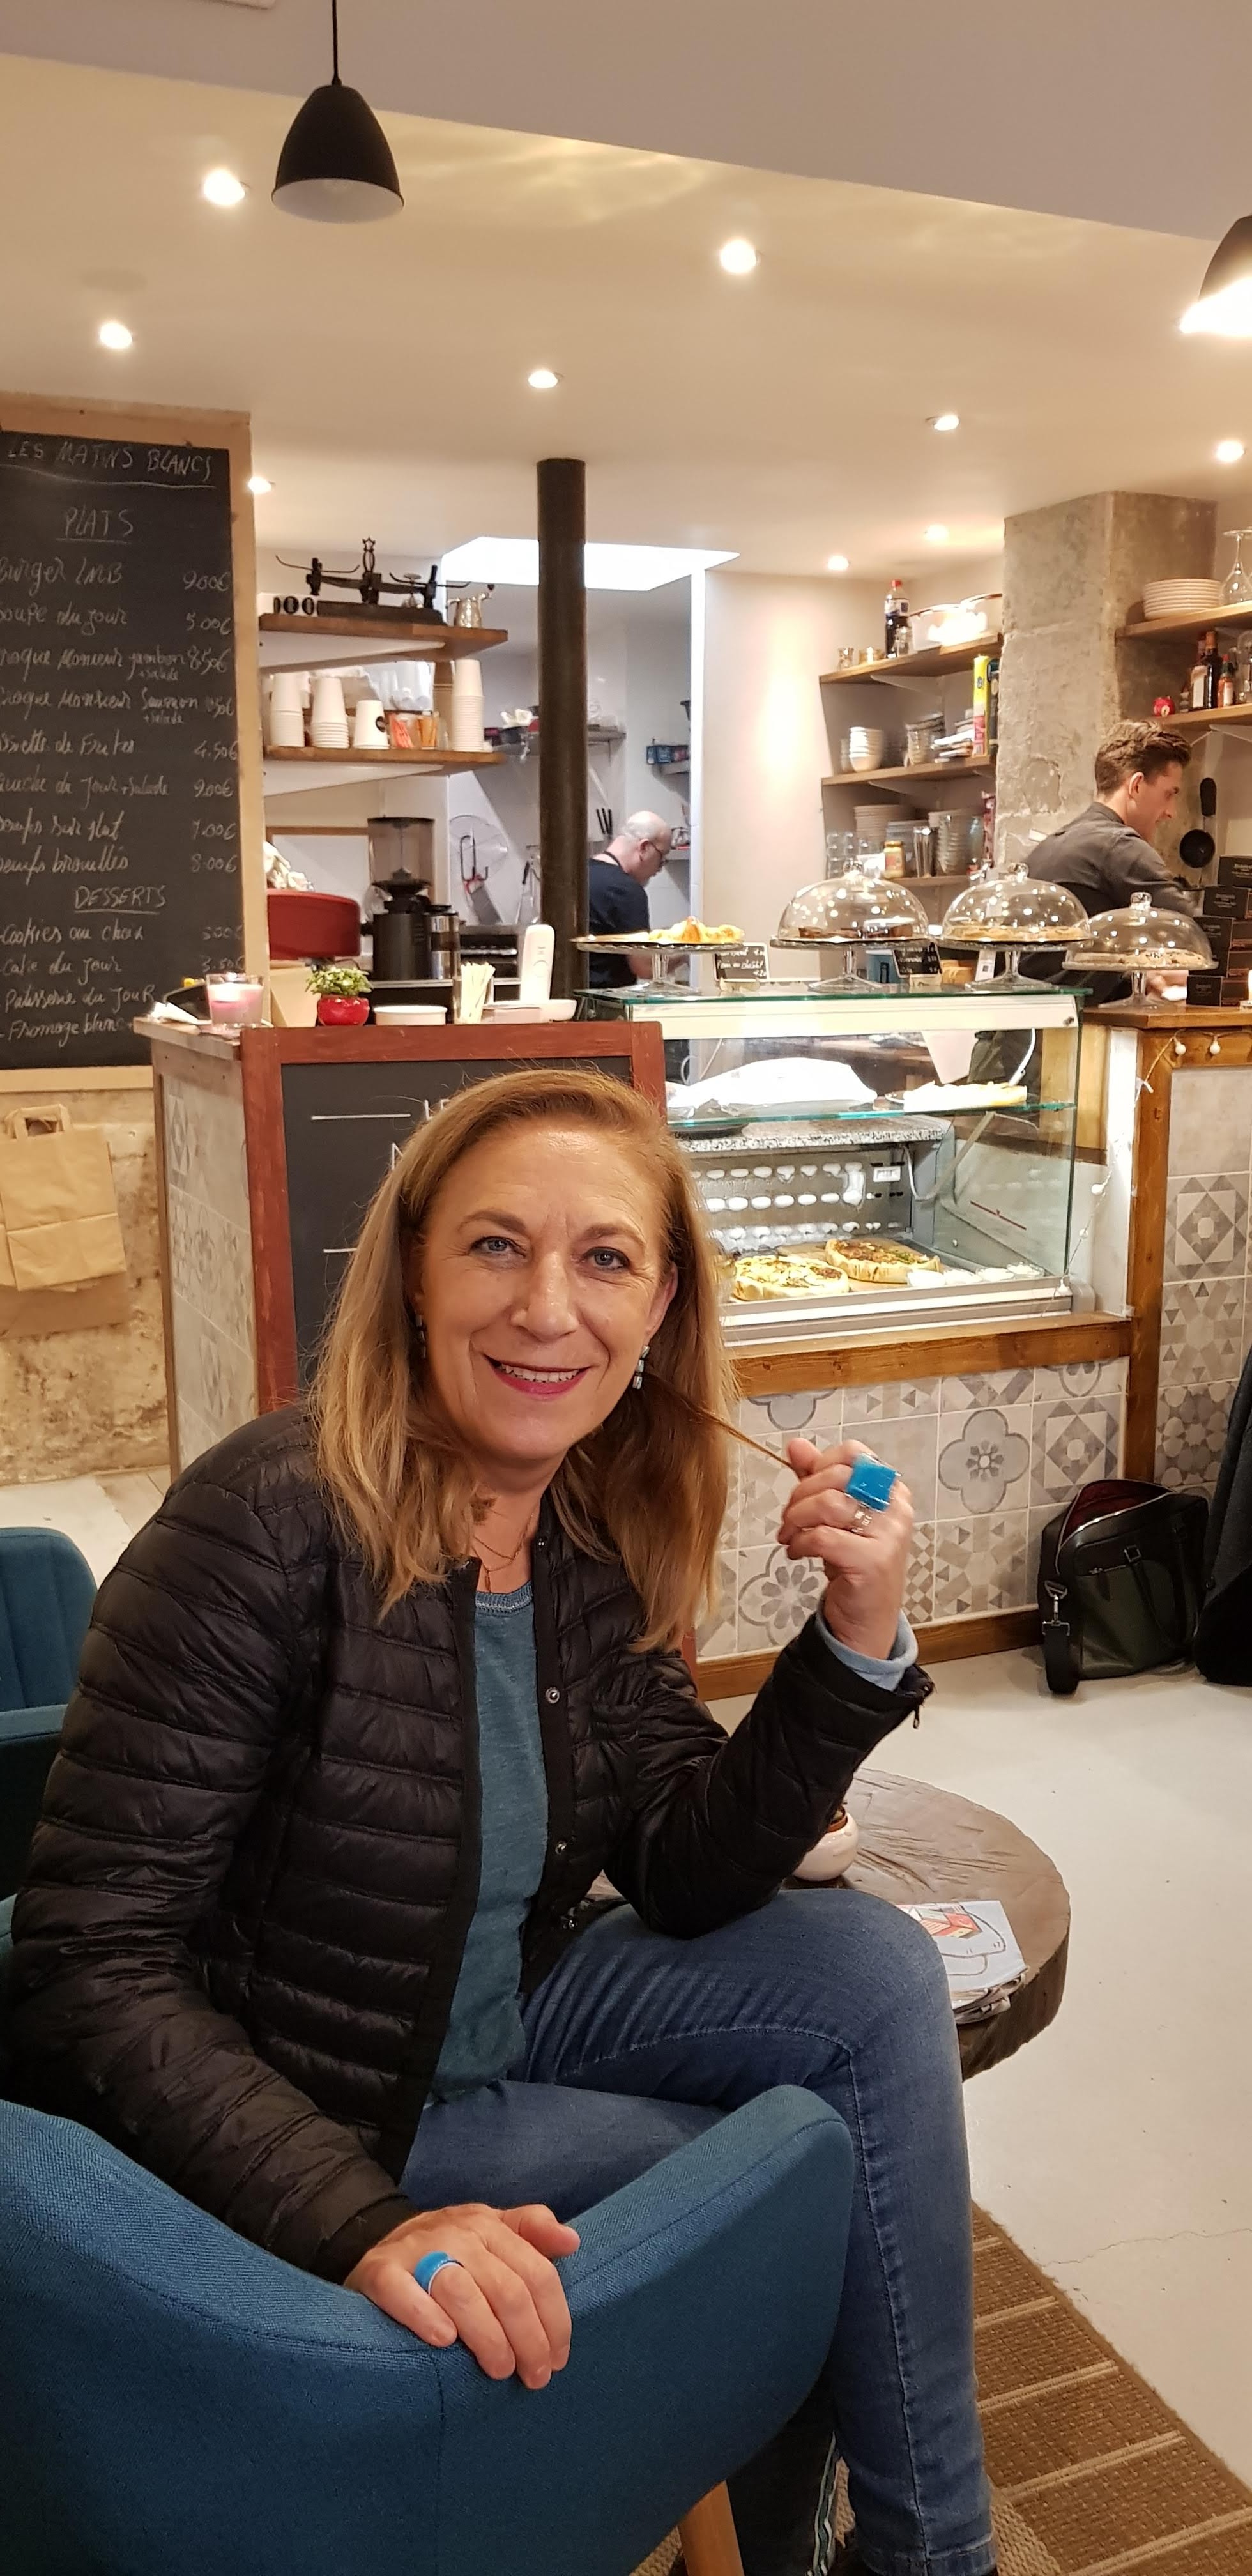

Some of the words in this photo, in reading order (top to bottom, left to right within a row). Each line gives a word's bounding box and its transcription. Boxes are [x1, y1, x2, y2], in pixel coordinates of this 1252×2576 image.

[57, 441, 133, 468] MATINS
[148, 448, 211, 482] BLANCS
[64, 507, 133, 538] PLATS
[75, 557, 122, 585] LMB
[57, 601, 81, 625] du
[0, 648, 50, 682] roque
[74, 885, 167, 909] DESSERTS
[70, 924, 92, 941] au
[49, 951, 73, 976] du
[82, 986, 105, 1007] du
